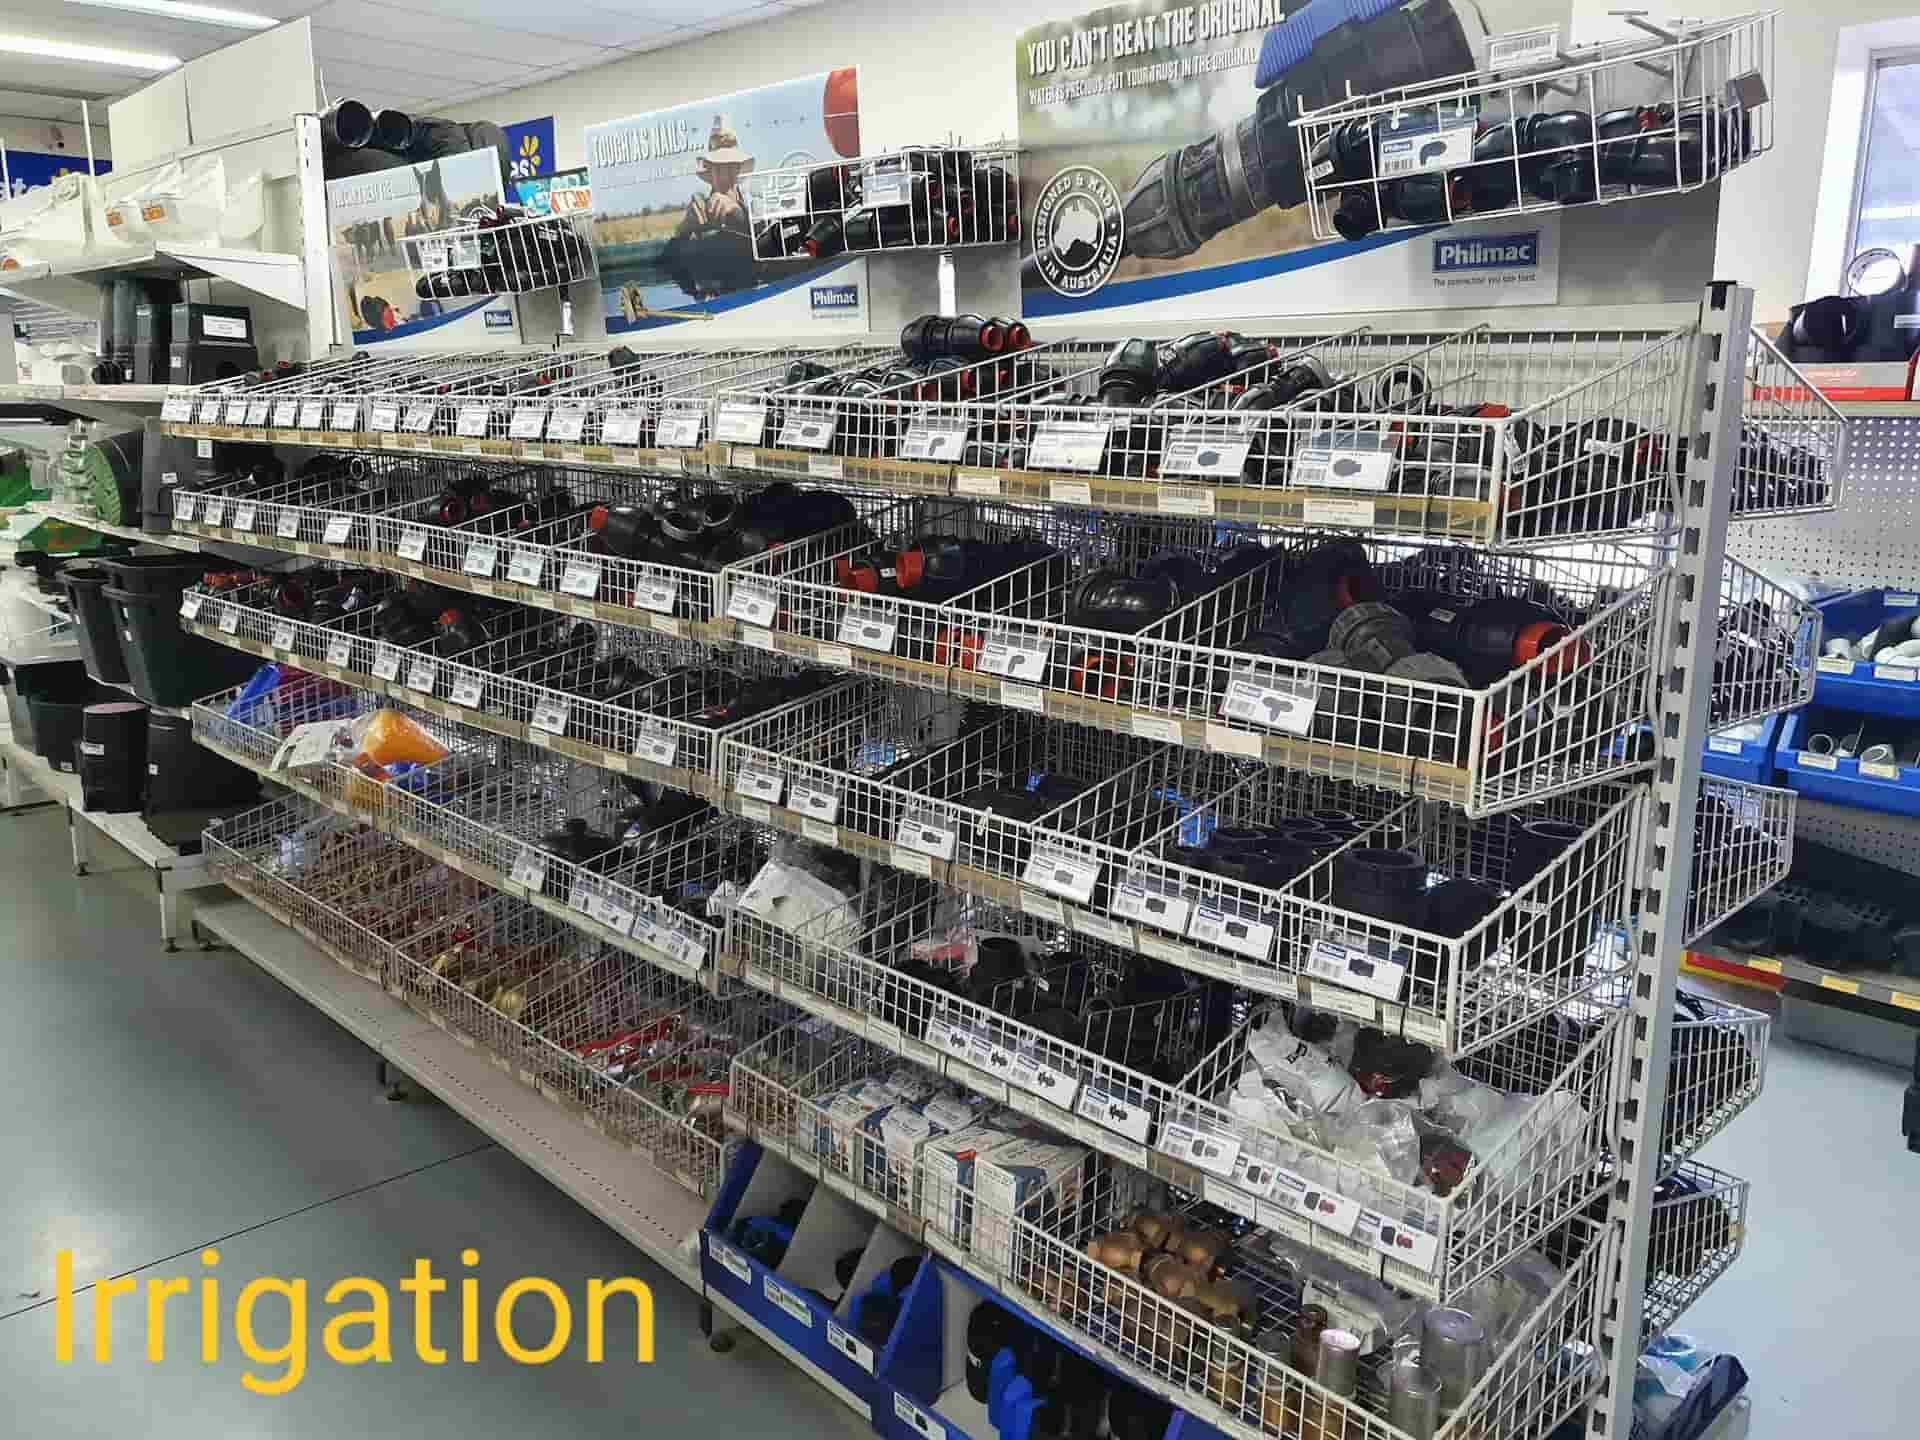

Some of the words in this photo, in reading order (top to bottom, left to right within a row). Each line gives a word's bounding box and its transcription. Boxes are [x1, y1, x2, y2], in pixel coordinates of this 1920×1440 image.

[1027, 39, 1058, 77] YOU
[1060, 29, 1109, 73] CAN'T
[1112, 15, 1158, 60] BEAT
[1162, 6, 1197, 49] THE
[1199, 0, 1285, 42] ORIGINAL
[1150, 60, 1181, 83] TRUST
[1182, 58, 1194, 79] IN
[592, 128, 631, 168] TOUGH
[631, 127, 650, 163] AS
[1037, 176, 1072, 249] DESIGNED
[1087, 177, 1117, 220] MADE
[1044, 259, 1060, 281] IN
[1060, 234, 1118, 290] AUSTRALIA
[1440, 243, 1532, 265] Philmac
[813, 290, 857, 306] Philmac
